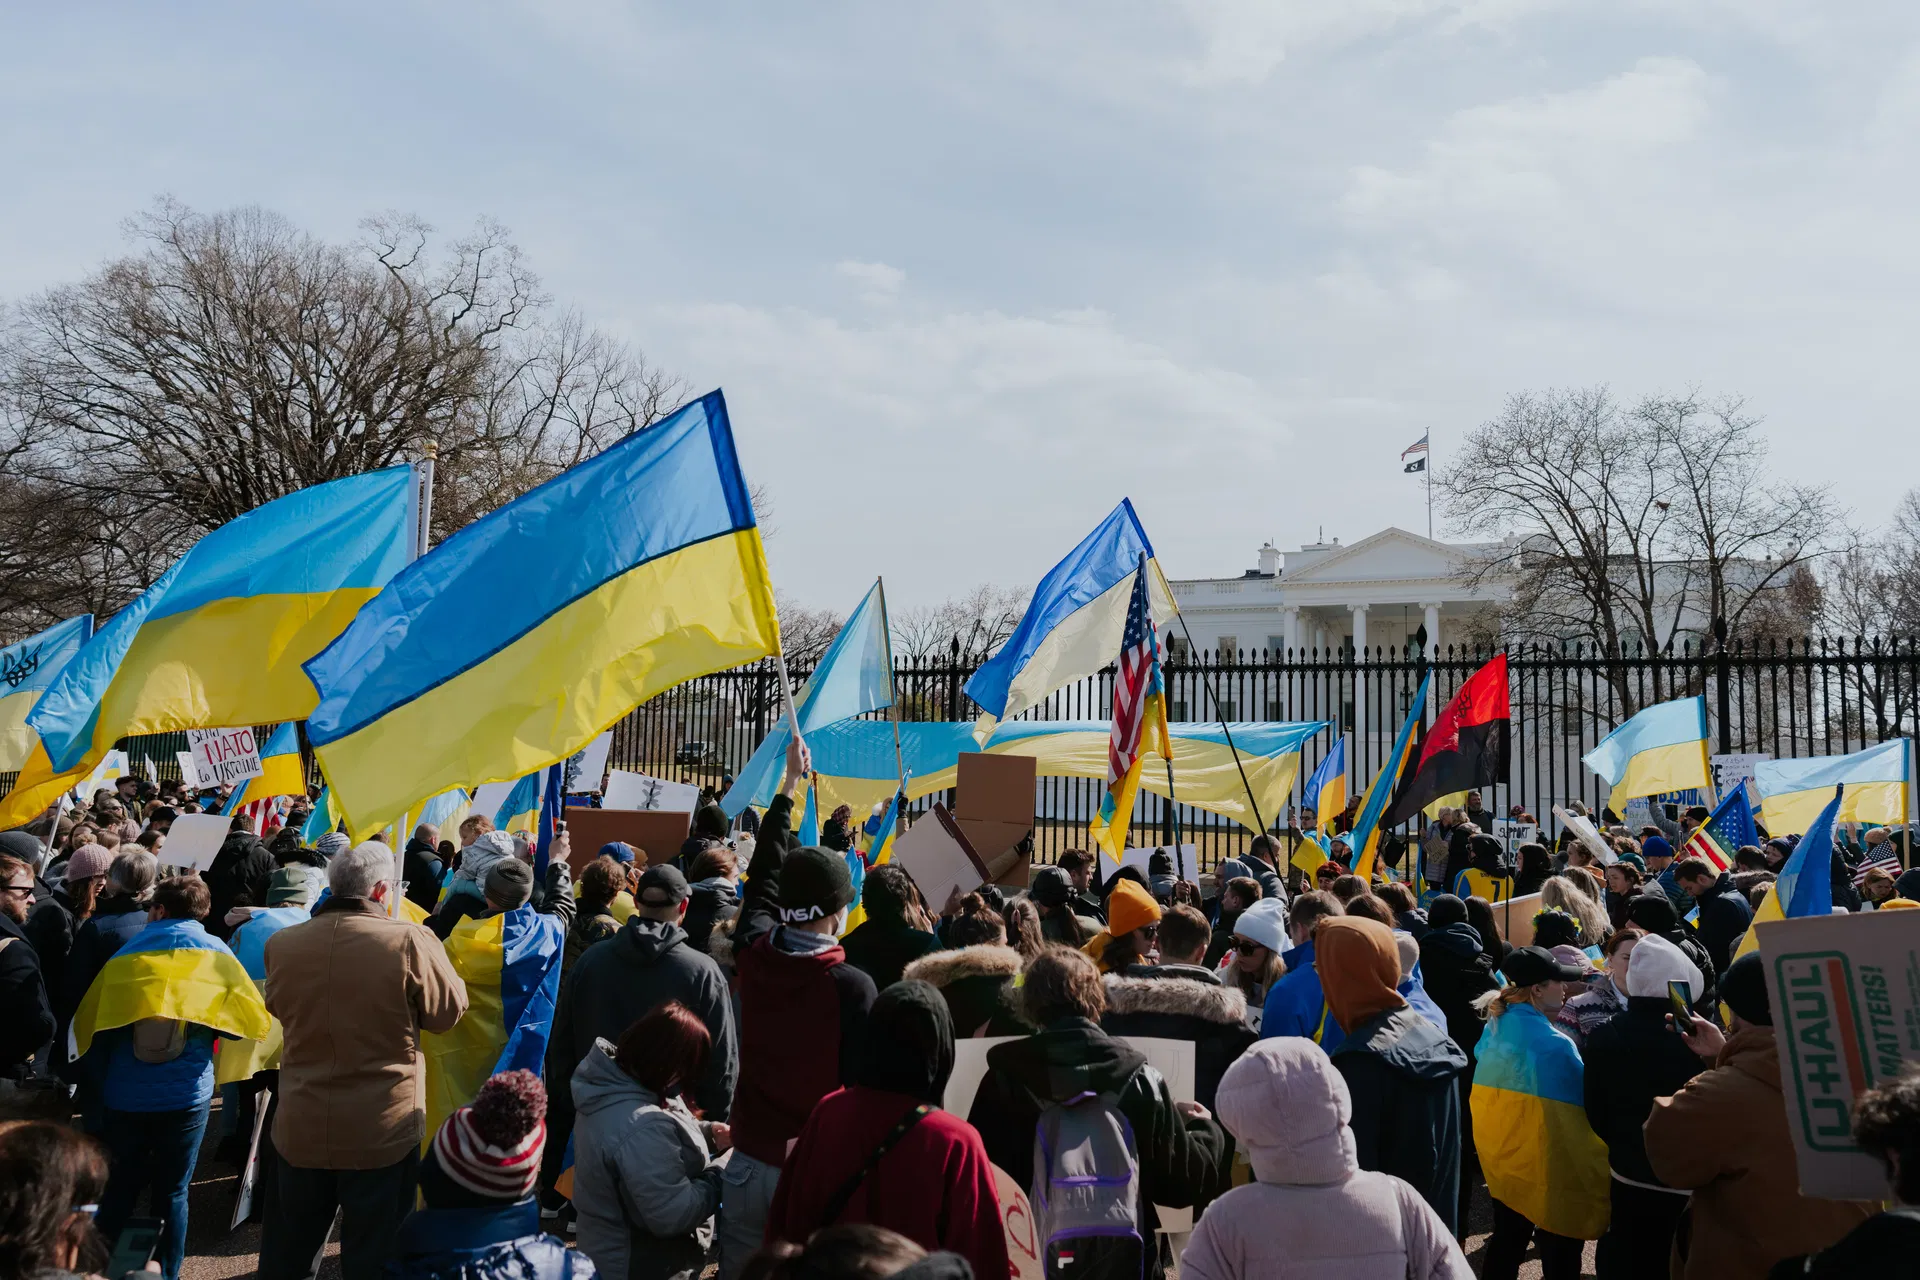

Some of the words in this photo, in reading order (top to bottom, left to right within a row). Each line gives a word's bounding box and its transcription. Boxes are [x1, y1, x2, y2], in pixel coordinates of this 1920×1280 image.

[204, 730, 254, 765] NATO
[1497, 827, 1531, 839] SUPPORT
[1858, 964, 1903, 1077] MATTERS!
